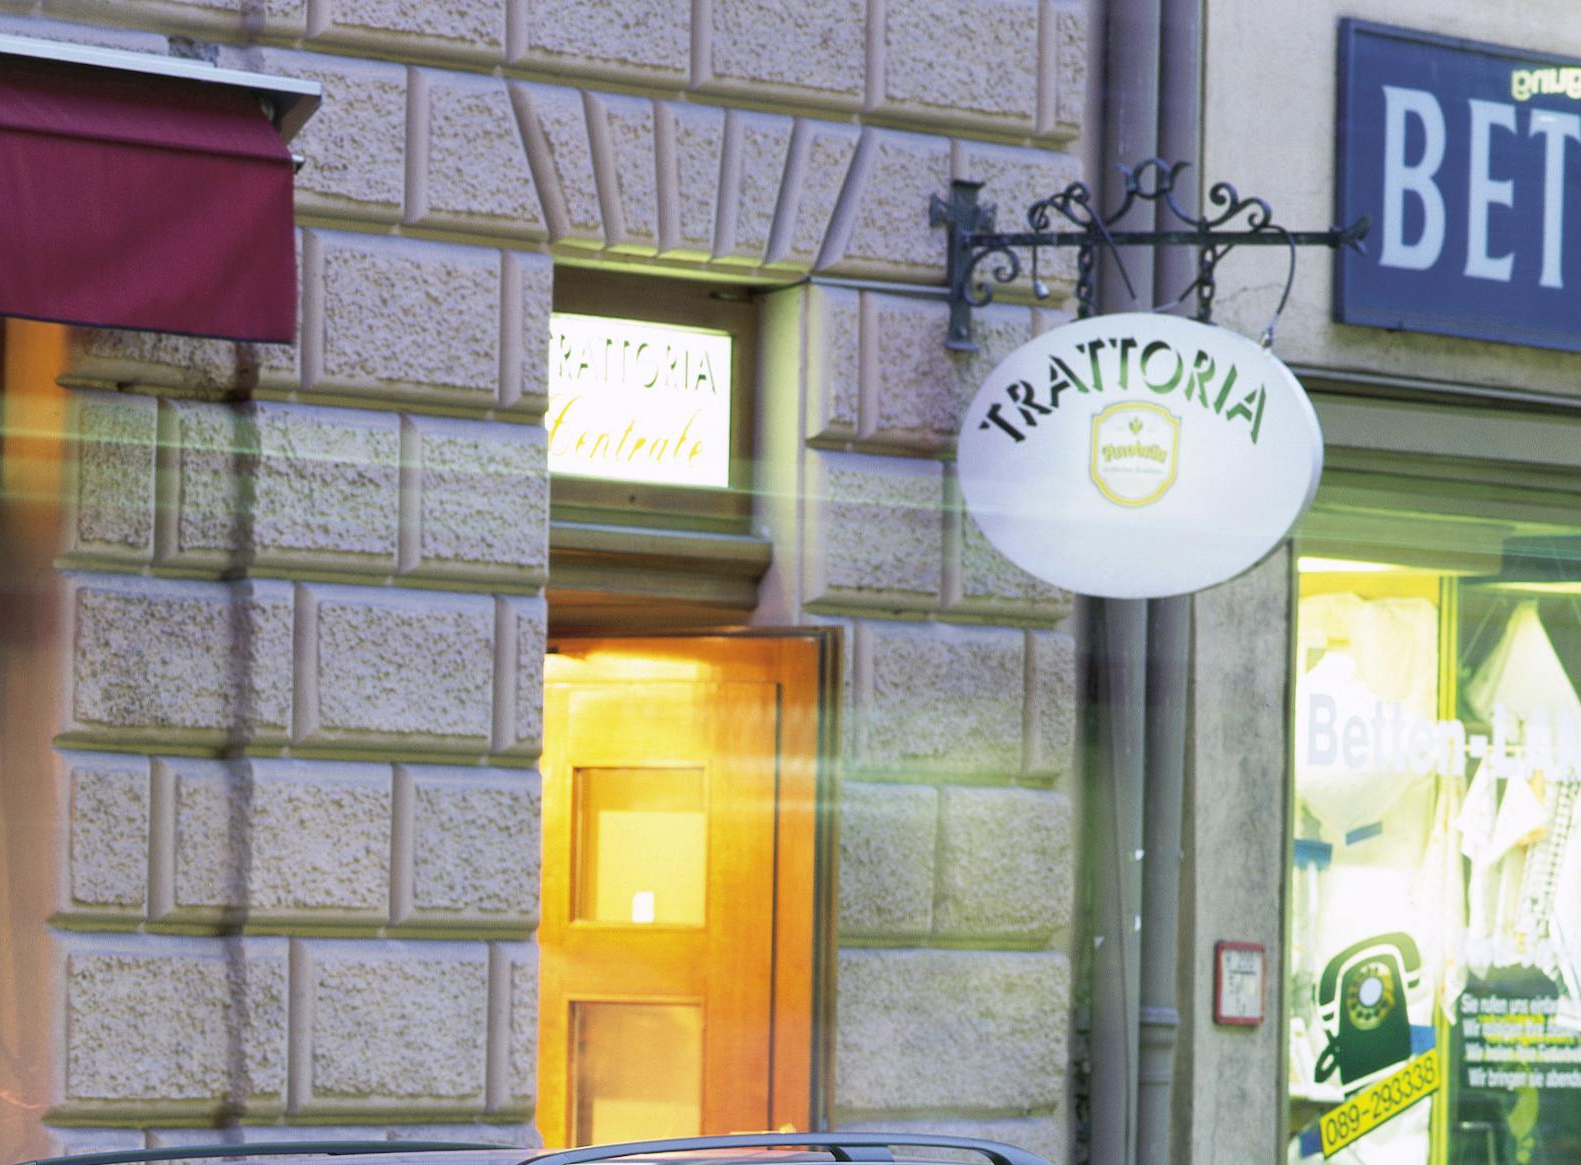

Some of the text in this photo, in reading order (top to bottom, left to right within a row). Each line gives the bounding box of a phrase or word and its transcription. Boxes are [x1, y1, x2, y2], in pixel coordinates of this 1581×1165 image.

[549, 328, 716, 394] RATTORIA
[979, 337, 1266, 445] TRATTORIA
[1326, 1056, 1435, 1146] 089-293338
